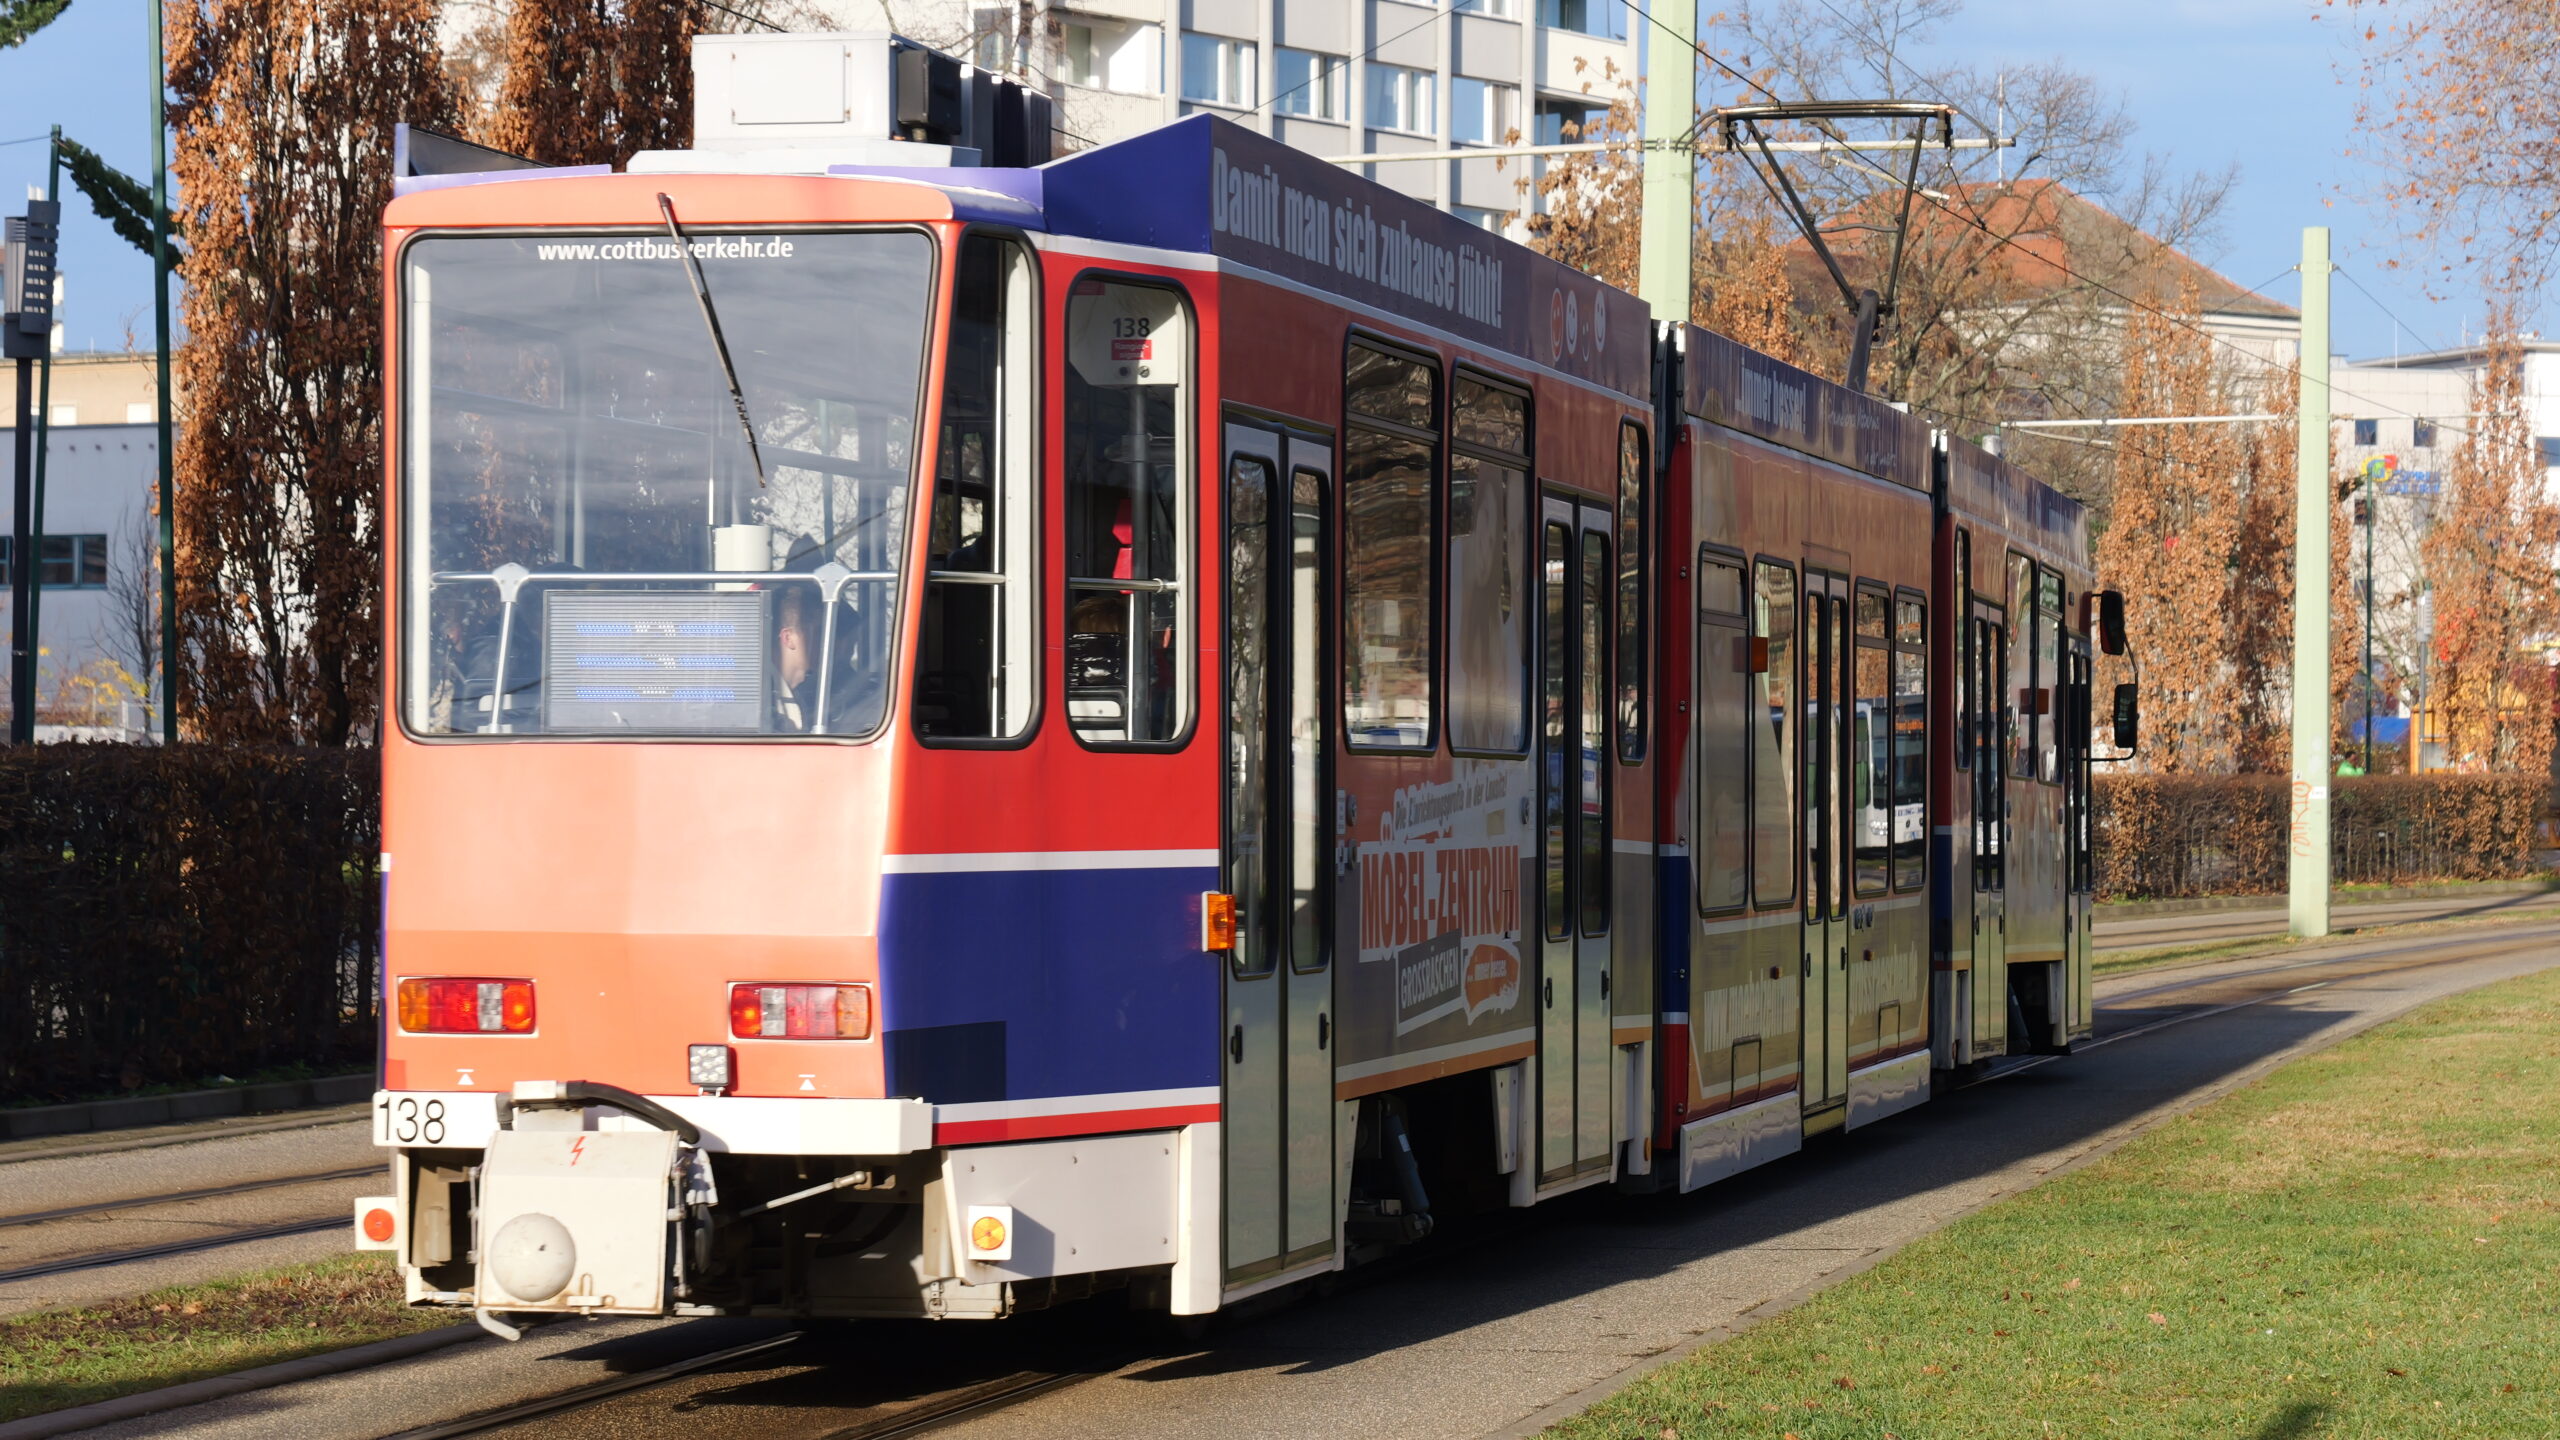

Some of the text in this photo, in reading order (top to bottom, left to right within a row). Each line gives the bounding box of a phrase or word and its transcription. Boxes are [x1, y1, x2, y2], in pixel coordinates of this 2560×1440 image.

[1213, 147, 1503, 330] Damit man sich zuhause fühlt!
[1112, 317, 1150, 338] 138
[1361, 823, 1520, 951] MÖBEL-ZENTRUM
[1400, 944, 1460, 1010] GROSSRÄSCHEN
[378, 1097, 446, 1144] 138
